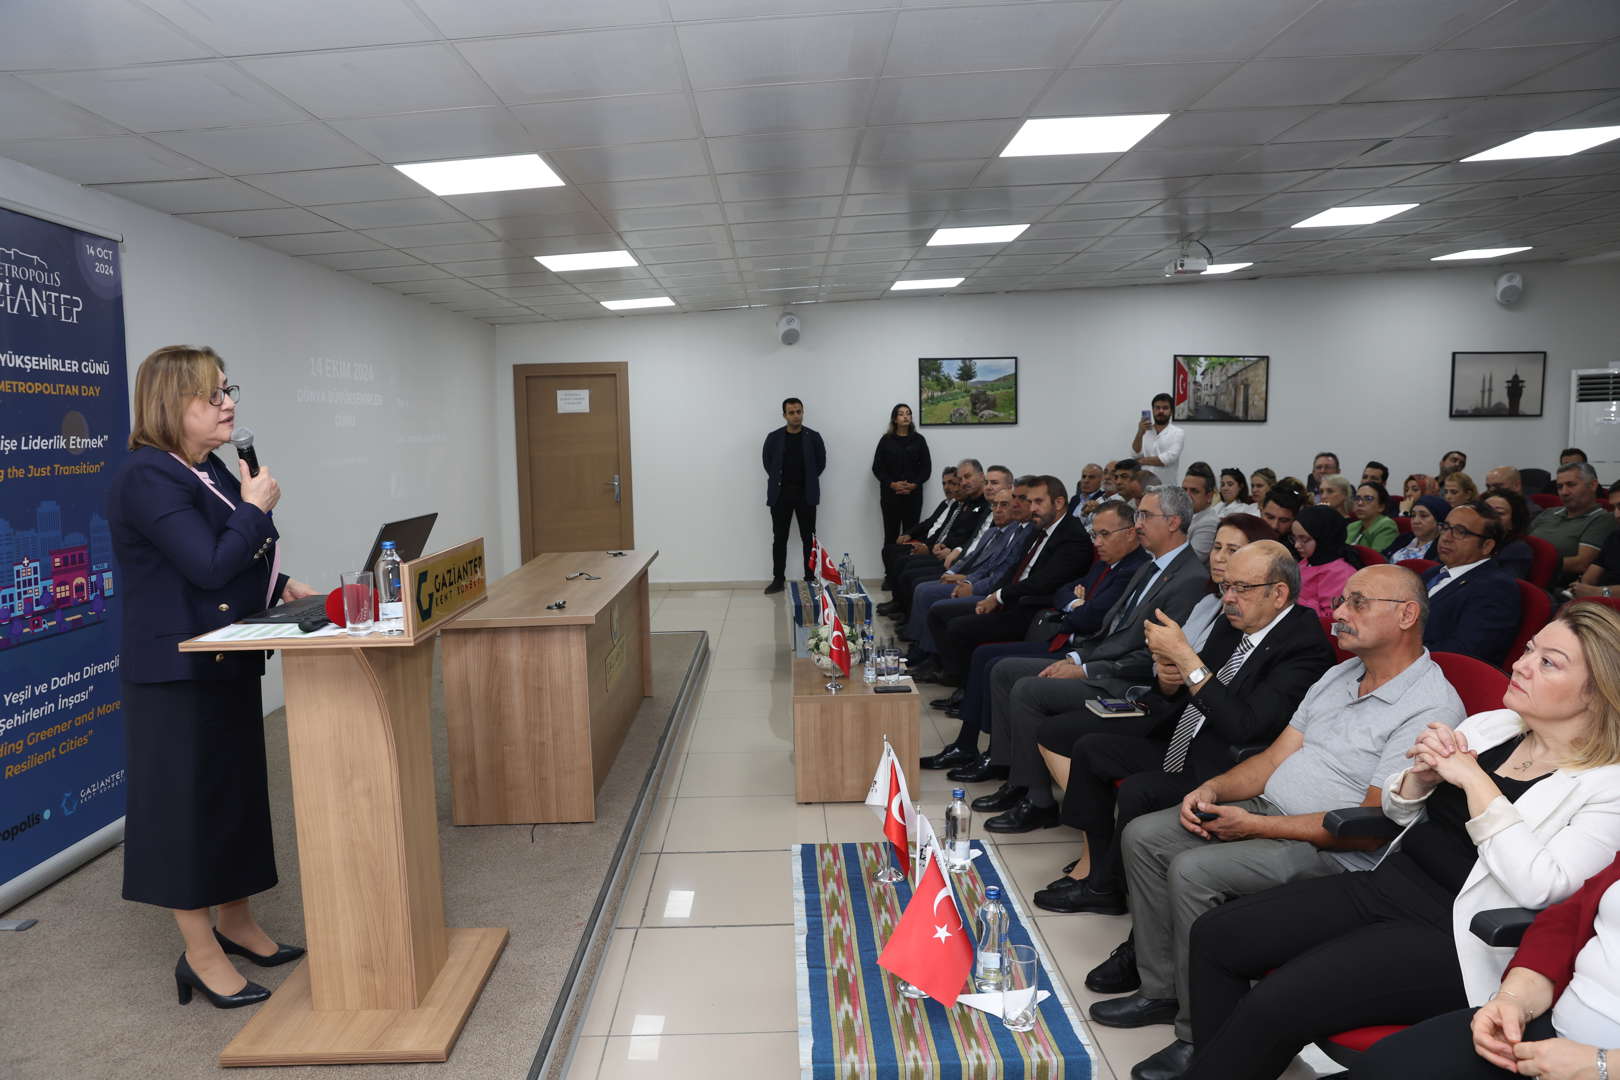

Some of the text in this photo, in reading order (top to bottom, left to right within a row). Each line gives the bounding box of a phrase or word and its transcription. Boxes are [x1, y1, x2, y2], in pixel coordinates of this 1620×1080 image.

[86, 244, 112, 261] 14 OCT
[95, 262, 114, 277] 2024
[0, 350, 110, 376] YÜKŞEHİRLER GÜNÜ
[81, 385, 101, 397] DAY
[21, 434, 66, 450] Liderlik
[7, 465, 25, 479] the
[27, 464, 51, 478] Just
[3, 685, 32, 706] Yeşil
[34, 682, 48, 696] ve
[51, 671, 81, 690] Daha
[0, 701, 55, 737] Şehirlerin
[27, 719, 73, 746] Greener
[74, 707, 95, 727] and
[97, 700, 121, 719] More
[4, 746, 56, 779] Resilient
[0, 813, 41, 842] opolis
